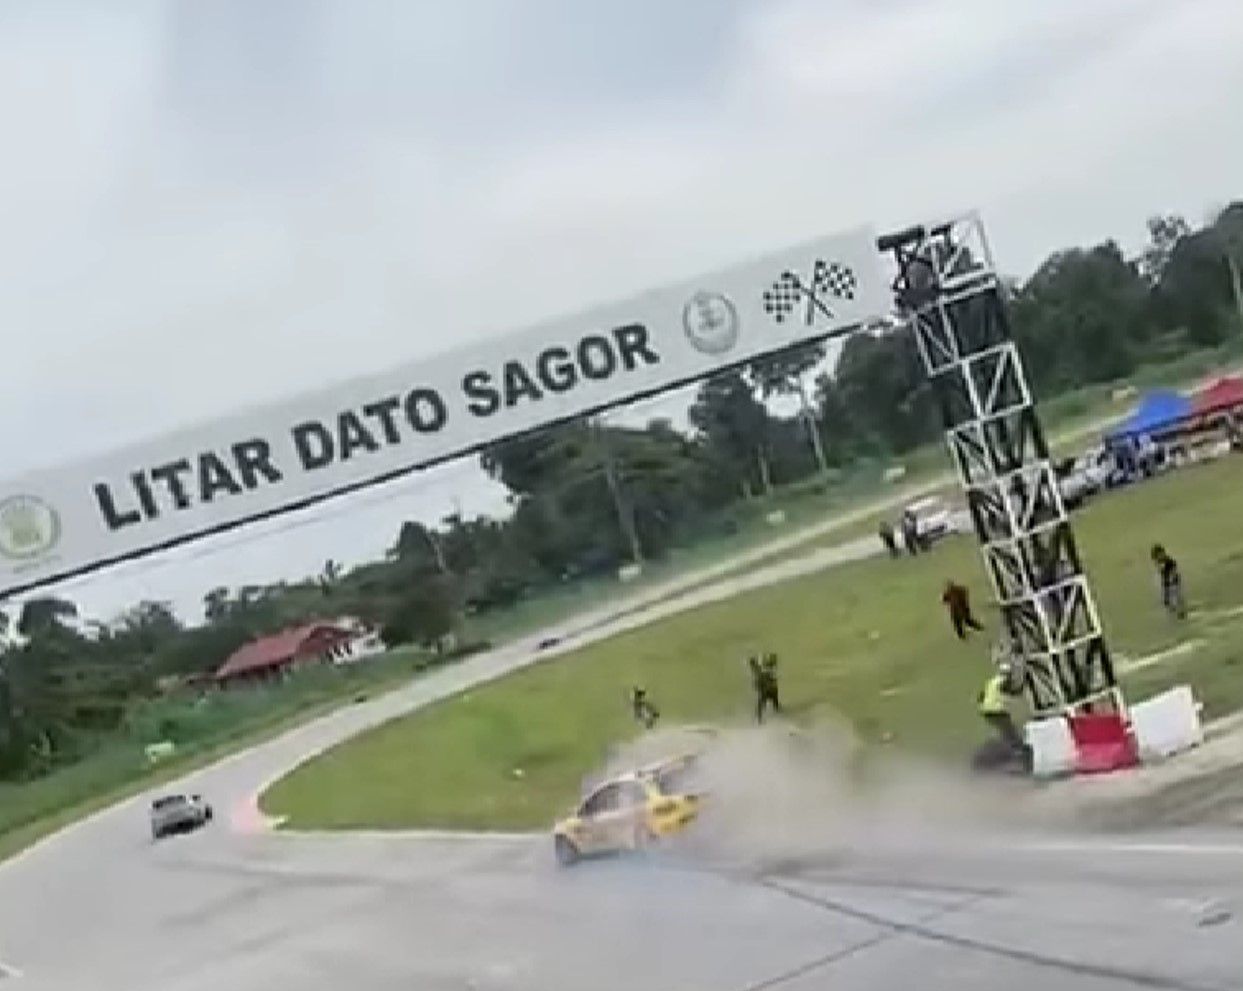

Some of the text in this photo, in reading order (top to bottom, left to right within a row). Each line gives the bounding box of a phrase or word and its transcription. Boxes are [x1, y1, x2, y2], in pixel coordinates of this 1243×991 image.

[94, 324, 660, 531] LITAR DATO SAGOR
